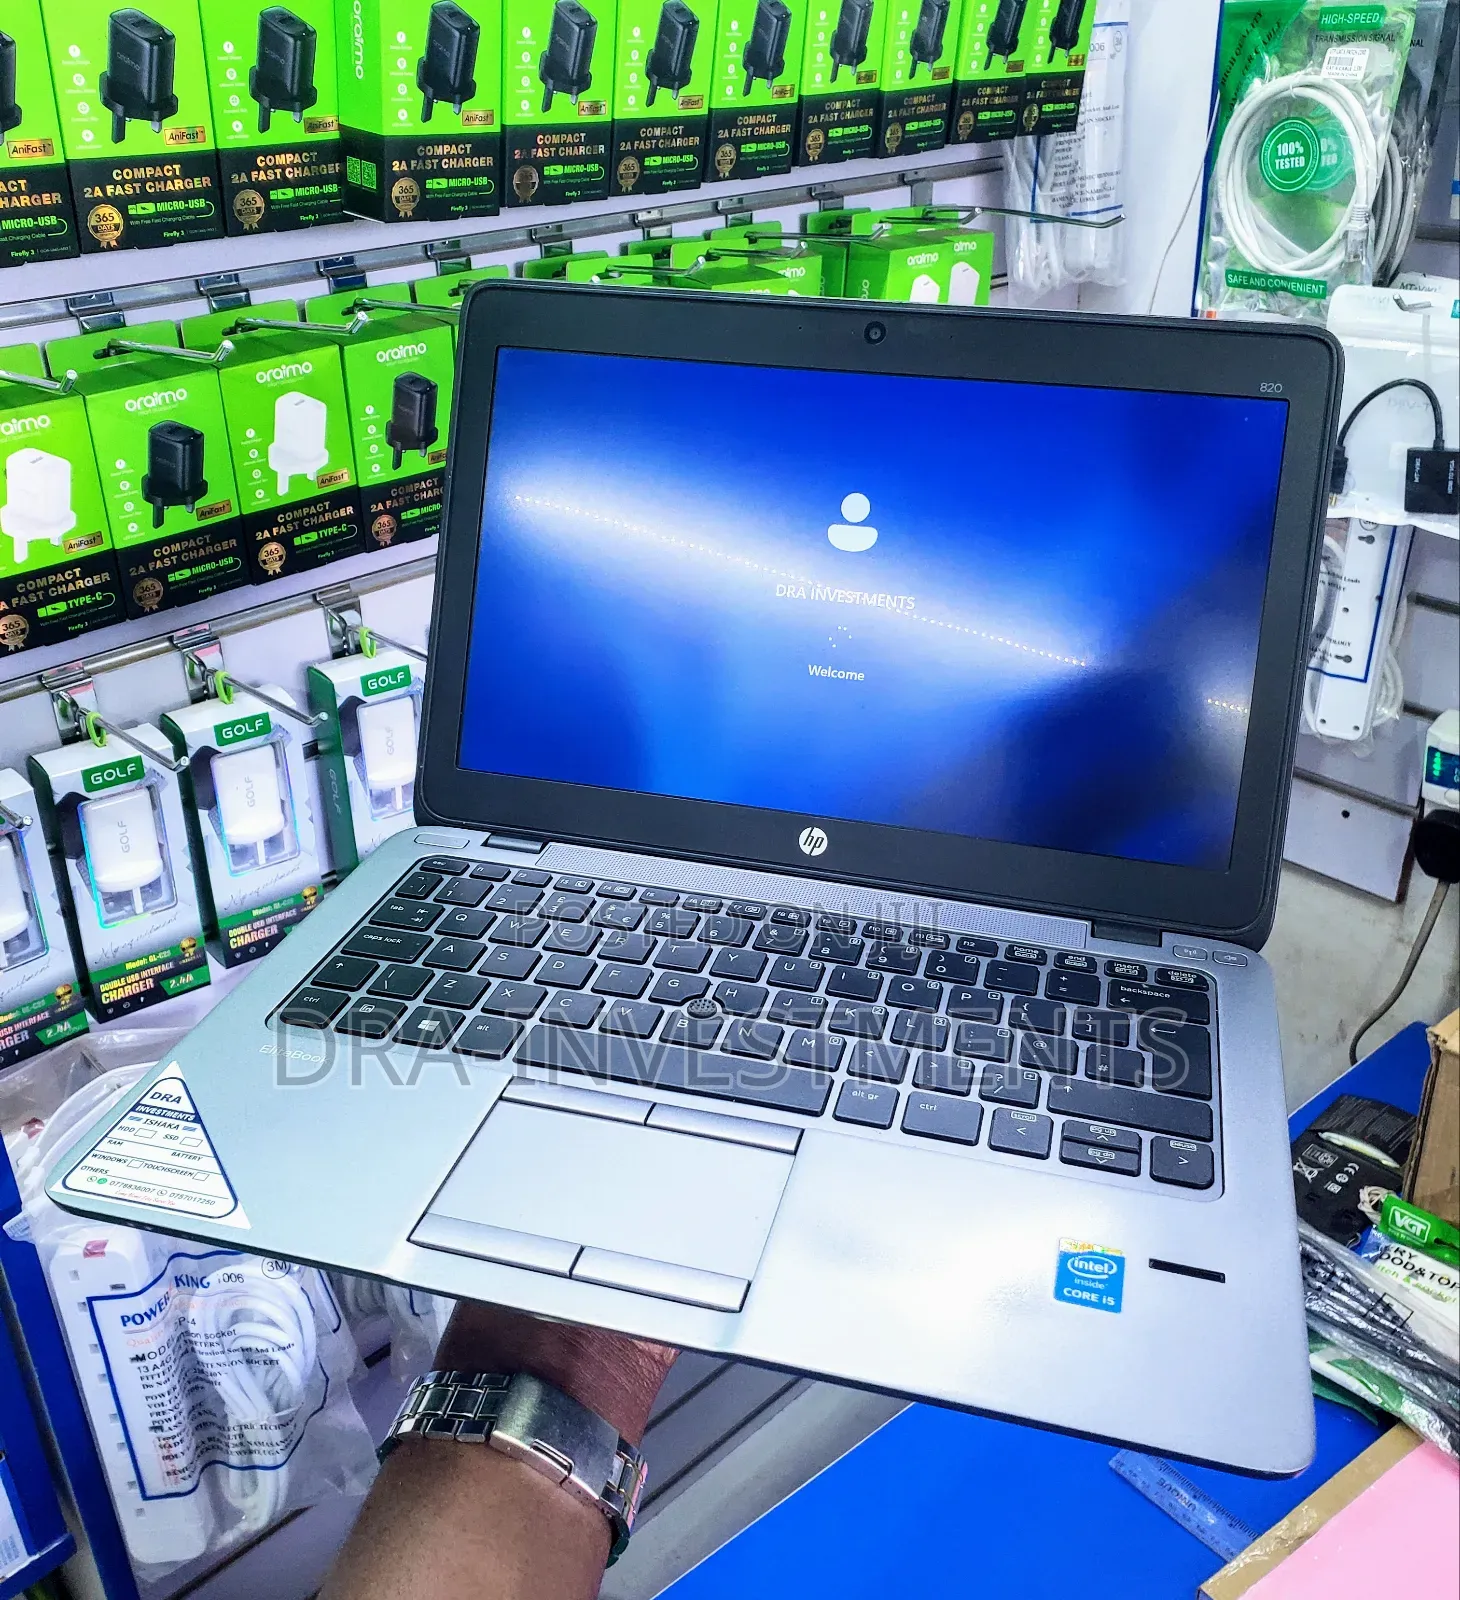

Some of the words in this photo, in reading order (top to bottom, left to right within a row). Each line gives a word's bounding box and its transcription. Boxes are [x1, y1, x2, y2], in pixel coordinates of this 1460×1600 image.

[1321, 13, 1380, 25] HIGH-SPEED
[353, 0, 364, 80] oraimo
[1315, 33, 1368, 43] TRANSMISSION
[1368, 33, 1396, 43] SIGNAL
[736, 114, 777, 125] COMPACT
[819, 112, 839, 123] FAST
[639, 125, 684, 137] COMPACT
[717, 130, 729, 139] 2A
[731, 128, 752, 138] FAST
[753, 124, 792, 136] CHARGER
[536, 132, 587, 145] COMPACT
[619, 142, 632, 151] 2A
[634, 139, 656, 150] FAST
[658, 136, 700, 149] CHARGER
[416, 143, 472, 157] COMPACT
[531, 147, 555, 158] FAST
[558, 144, 605, 156] CHARGER
[1276, 140, 1304, 156] 100%
[256, 152, 318, 167] COMPACT
[391, 160, 408, 171] 2A
[410, 158, 439, 170] FAST
[441, 156, 494, 169] CHARGER
[662, 154, 694, 164] MICRO-USB
[1275, 156, 1305, 170] TESTED
[112, 164, 181, 180] COMPACT
[564, 163, 599, 174] MICRO-USB
[230, 172, 248, 184] 2A
[251, 168, 281, 182] FAST
[448, 176, 488, 188] MICRO-USB
[83, 187, 103, 198] 2A
[106, 182, 141, 197] FAST
[145, 176, 212, 193] CHARGER
[295, 184, 338, 197] MICRO-USB
[398, 185, 414, 194] 365
[156, 198, 206, 212] MICRO-USB
[239, 197, 257, 207] 365
[2, 216, 57, 230] MICRO-USB
[95, 212, 115, 223] 365
[97, 223, 115, 231] DAYS
[907, 252, 939, 266] oraimo
[1227, 273, 1248, 285] SAFE
[1250, 276, 1266, 287] AND
[1268, 278, 1325, 295] CONVENIENT
[376, 342, 427, 363] oraimo
[255, 361, 313, 384] oraimo
[1259, 382, 1283, 393] 820
[124, 388, 188, 412] oraimo
[390, 478, 439, 497] COMPACT
[370, 502, 384, 513] 2A
[386, 495, 411, 509] FAST
[277, 501, 331, 523] COMPACT
[255, 530, 271, 541] 2A
[272, 521, 300, 536] FAST
[302, 505, 355, 528] CHARGER
[318, 523, 348, 539] TYPE-C
[153, 534, 211, 558] COMPACT
[129, 566, 146, 577] 2A
[148, 555, 178, 570] FAST
[181, 538, 238, 562] CHARGER
[263, 548, 280, 558] 365
[191, 556, 234, 575] MICRO-USB
[16, 567, 82, 593] COMPACT
[11, 591, 45, 608] FAST
[48, 572, 111, 597] CHARGER
[140, 584, 156, 593] 365
[67, 591, 103, 609] TYPE-C
[775, 584, 807, 599] DRA
[810, 586, 916, 610] INVESTMENTS
[2, 620, 21, 632] 365
[808, 664, 865, 681] Welcome
[367, 672, 405, 689] GOLF
[221, 719, 264, 739] GOLF
[90, 763, 137, 785] GOLF
[117, 820, 131, 853] GOLF
[799, 826, 828, 857] hp
[390, 904, 404, 912] tab
[455, 913, 468, 922] Q
[229, 924, 278, 949] CHARGER
[363, 933, 383, 942] caps
[383, 934, 403, 944] lock
[442, 944, 455, 953] A
[1013, 945, 1039, 955] home
[498, 952, 509, 960] S
[728, 953, 739, 962] Y
[552, 960, 565, 969] D
[784, 963, 795, 971] U
[100, 976, 126, 993] DOUBLE
[126, 972, 140, 984] USB
[140, 961, 175, 979] INTERFACE
[608, 969, 621, 978] F
[442, 979, 457, 988] Z
[667, 979, 680, 988] G
[101, 977, 155, 1005] CHARGER
[500, 988, 515, 997] X
[726, 988, 738, 997] H
[961, 992, 972, 1001] P
[1120, 985, 1171, 999] backspace
[303, 995, 321, 1004] ctrl
[476, 1024, 490, 1032] alt
[150, 1091, 182, 1104] DRA
[852, 1089, 866, 1097] alt
[867, 1092, 880, 1101] gr
[135, 1104, 197, 1122] INVESTMENTS
[117, 1125, 136, 1133] HDD
[142, 1118, 180, 1131] ISHAKA
[107, 1139, 124, 1147] RAM
[162, 1133, 179, 1141] SSD
[91, 1152, 128, 1164] WINDOWS
[171, 1151, 204, 1162] BATTERY
[80, 1165, 110, 1175] OTHERS
[142, 1162, 194, 1178] TOUCHSCREEN
[1394, 1210, 1427, 1237] VGT
[266, 1260, 287, 1272] 3M
[1073, 1257, 1111, 1274] intel
[1074, 1278, 1105, 1290] inside
[120, 1290, 171, 1327] POWER
[174, 1273, 211, 1289] KING
[1063, 1287, 1099, 1302] CORE
[1102, 1296, 1116, 1306] i5
[204, 1329, 237, 1341] socket
